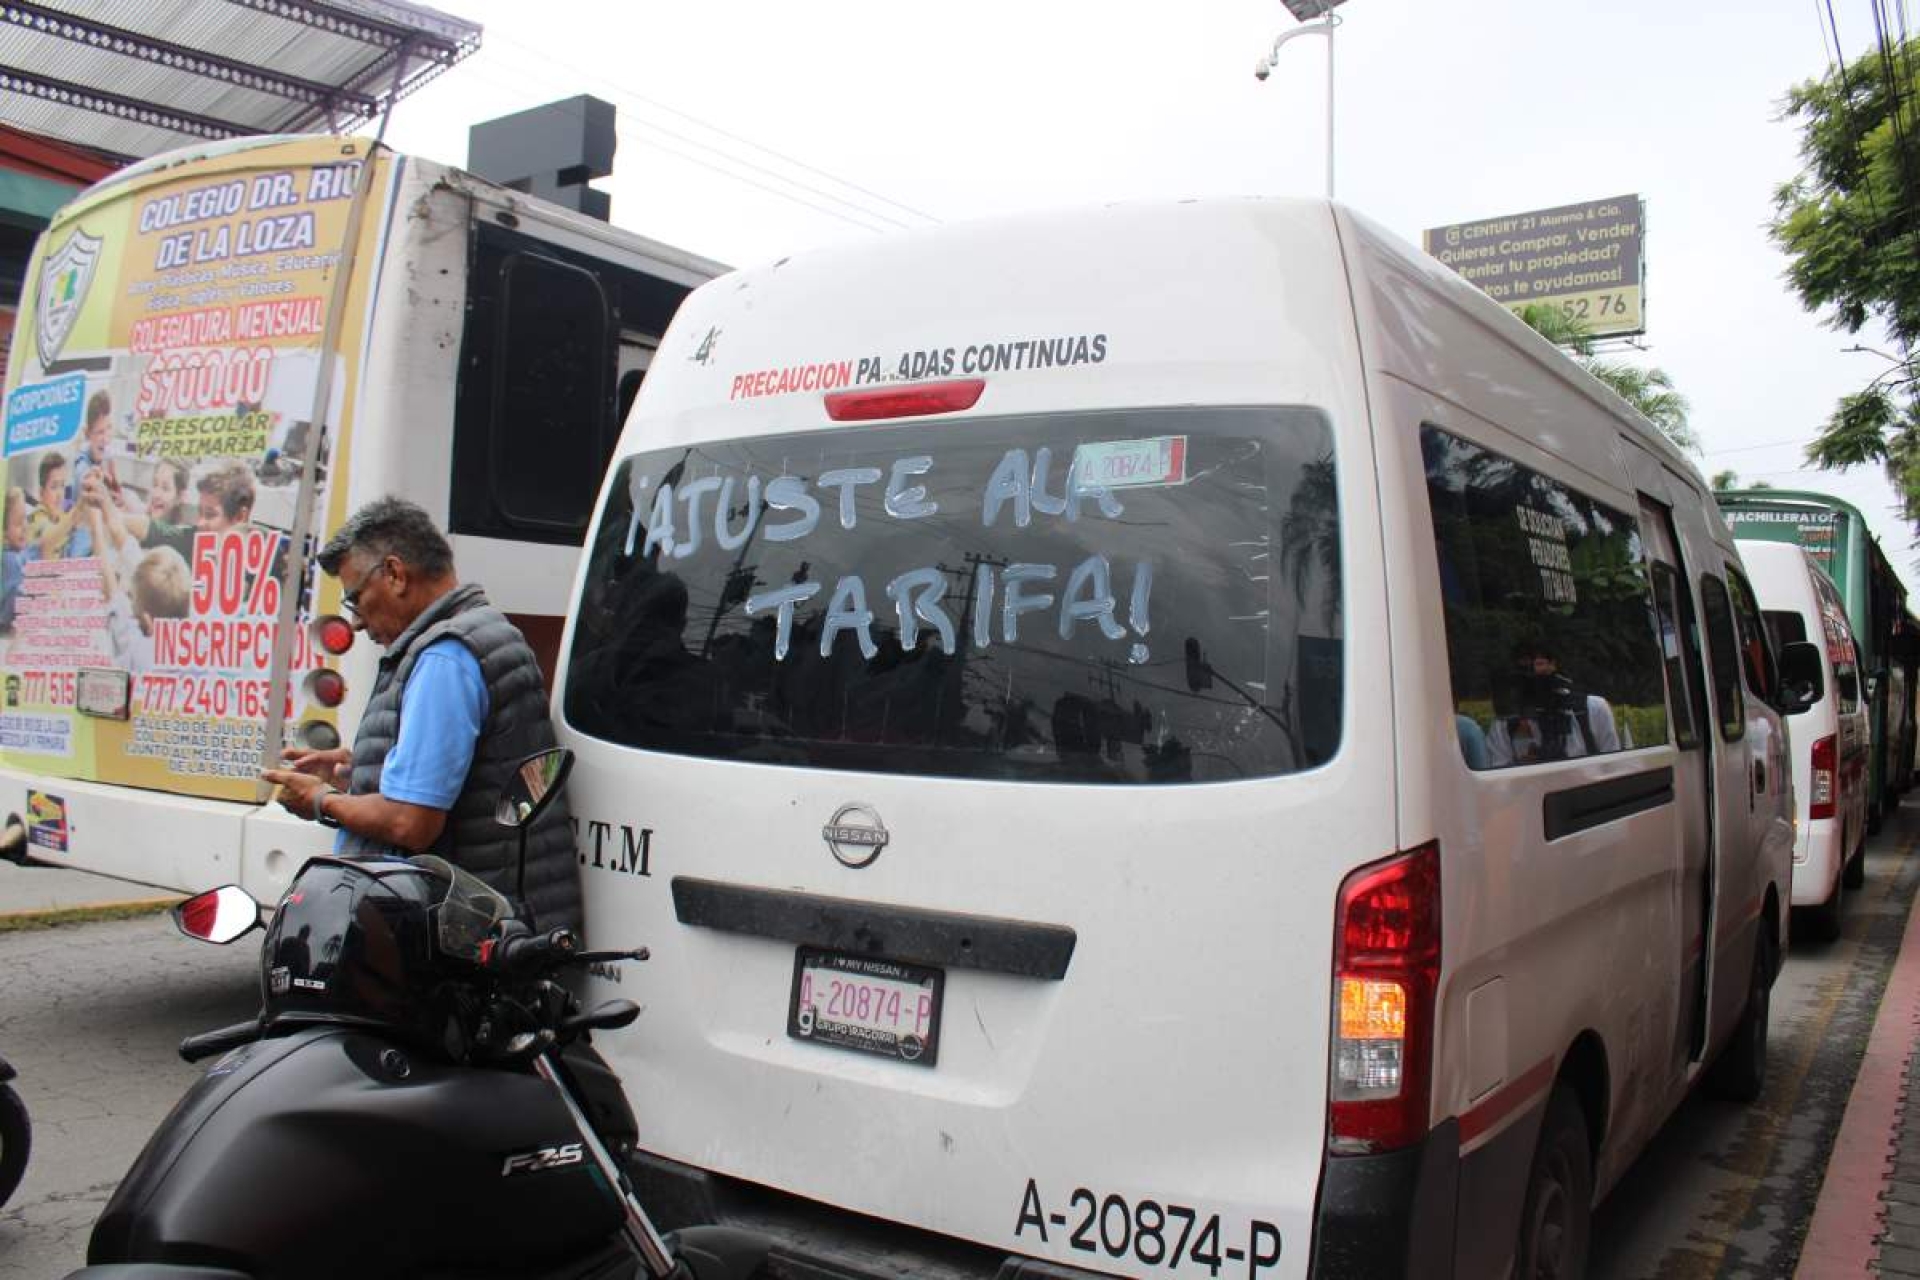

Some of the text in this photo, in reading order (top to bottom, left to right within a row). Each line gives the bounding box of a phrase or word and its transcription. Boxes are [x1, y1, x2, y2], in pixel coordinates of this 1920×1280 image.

[139, 180, 245, 234] COLEGIO
[247, 171, 300, 212] DR.
[156, 212, 315, 270] DE LA LOZA
[1463, 218, 1518, 239] CENTURY
[1522, 217, 1535, 230] 21
[1508, 258, 1523, 273] tu
[1527, 242, 1621, 273] propiedad?
[1514, 279, 1529, 295] te
[1533, 265, 1623, 293] ayudamos!
[1599, 294, 1627, 315] 76
[128, 308, 232, 354] COLEGIATURA
[232, 297, 323, 341] MENSUAL
[730, 334, 1108, 401] PRECAUCION PAADAS CONTINUAS
[138, 412, 270, 438] PREESCOLAR
[157, 433, 267, 457] PRIMARIA
[193, 533, 280, 617] 50%
[745, 554, 1152, 665] TARIFA!
[23, 671, 46, 705] 777
[142, 676, 178, 711] 777
[182, 677, 228, 716] 240
[164, 733, 207, 749] LOMAS
[210, 736, 229, 750] DE
[232, 737, 252, 751] LA
[191, 749, 260, 766] MERCADO
[567, 815, 654, 877] .T.M
[823, 827, 886, 844] NISSAN
[863, 961, 900, 977] NISSAN
[800, 972, 932, 1034] A-20874-P
[1014, 1177, 1282, 1280] A-20874-P
